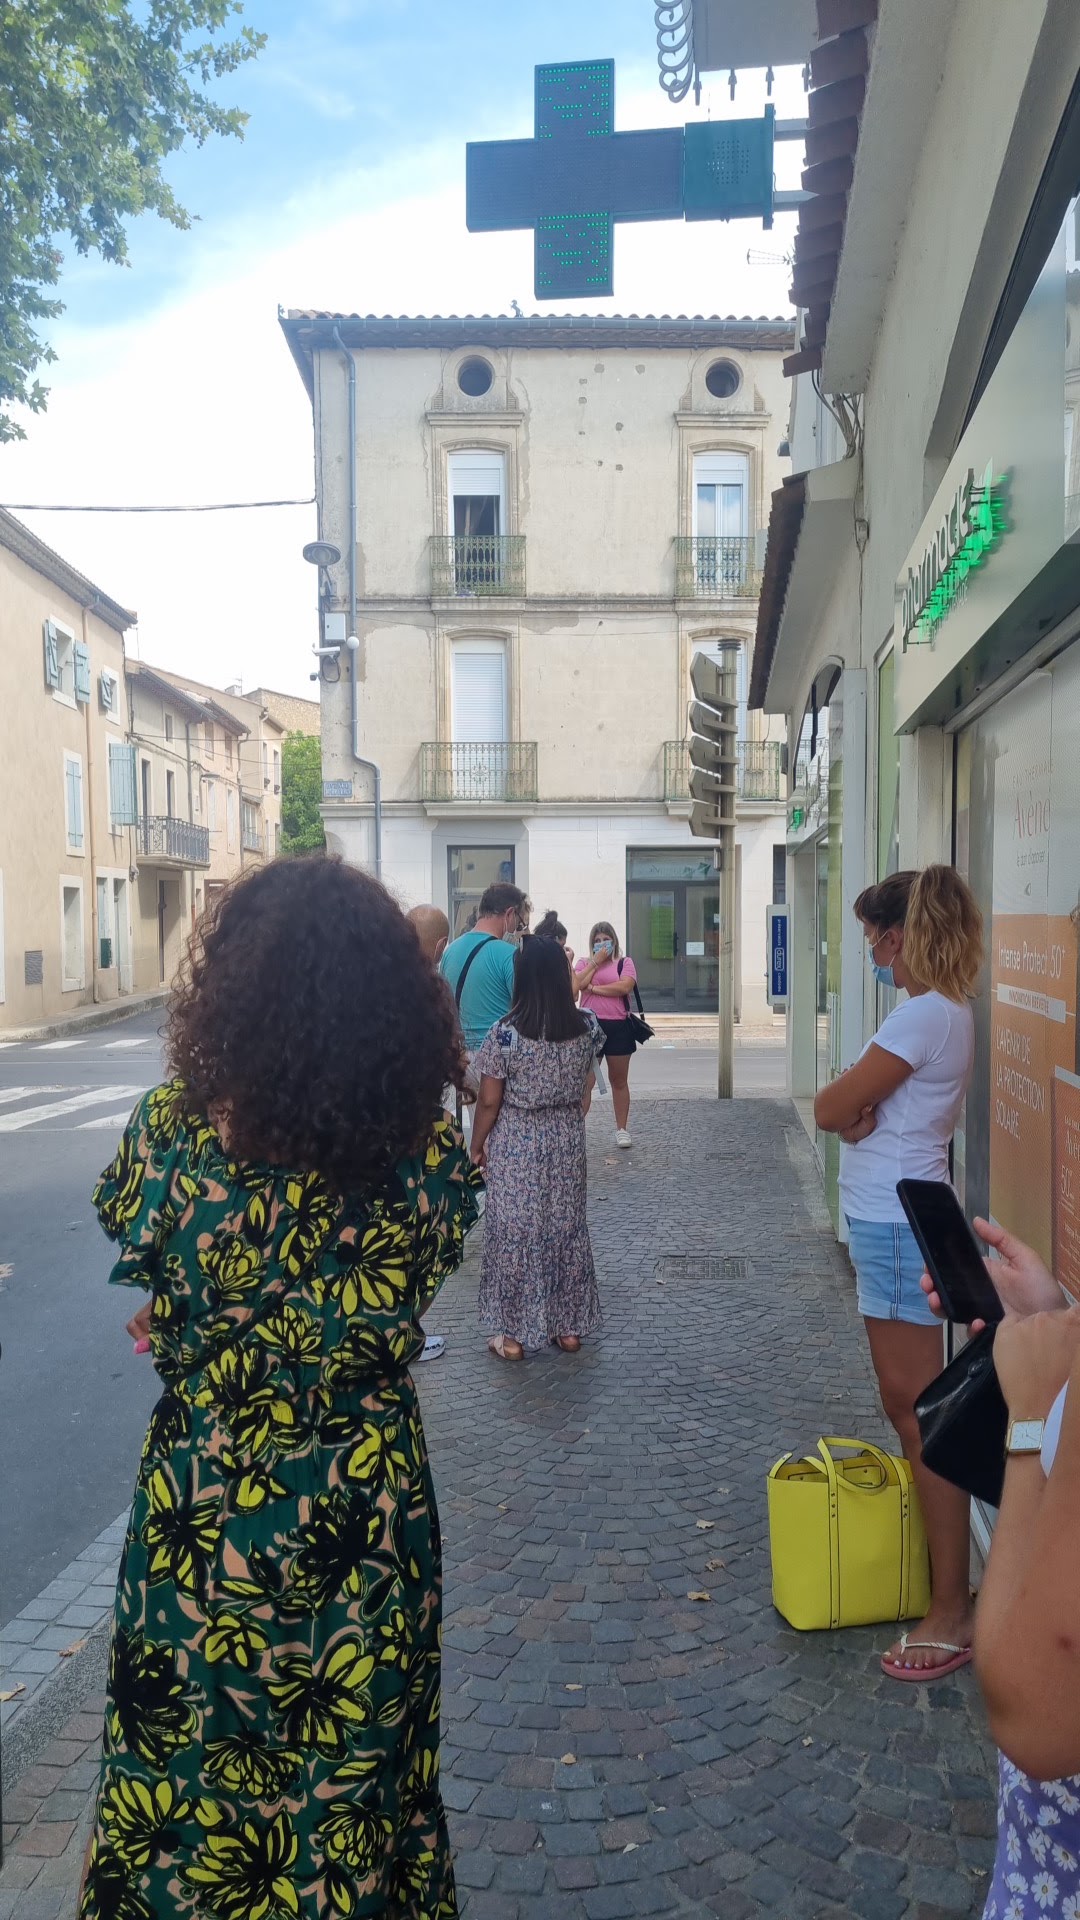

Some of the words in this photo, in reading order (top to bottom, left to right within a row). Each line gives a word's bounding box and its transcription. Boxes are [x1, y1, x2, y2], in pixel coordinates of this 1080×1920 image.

[998, 938, 1021, 970] Intense
[1022, 940, 1048, 975] Protect
[1021, 1035, 1031, 1065] DE
[995, 1061, 1003, 1088] LA
[1003, 1065, 1045, 1113] PROTECTION
